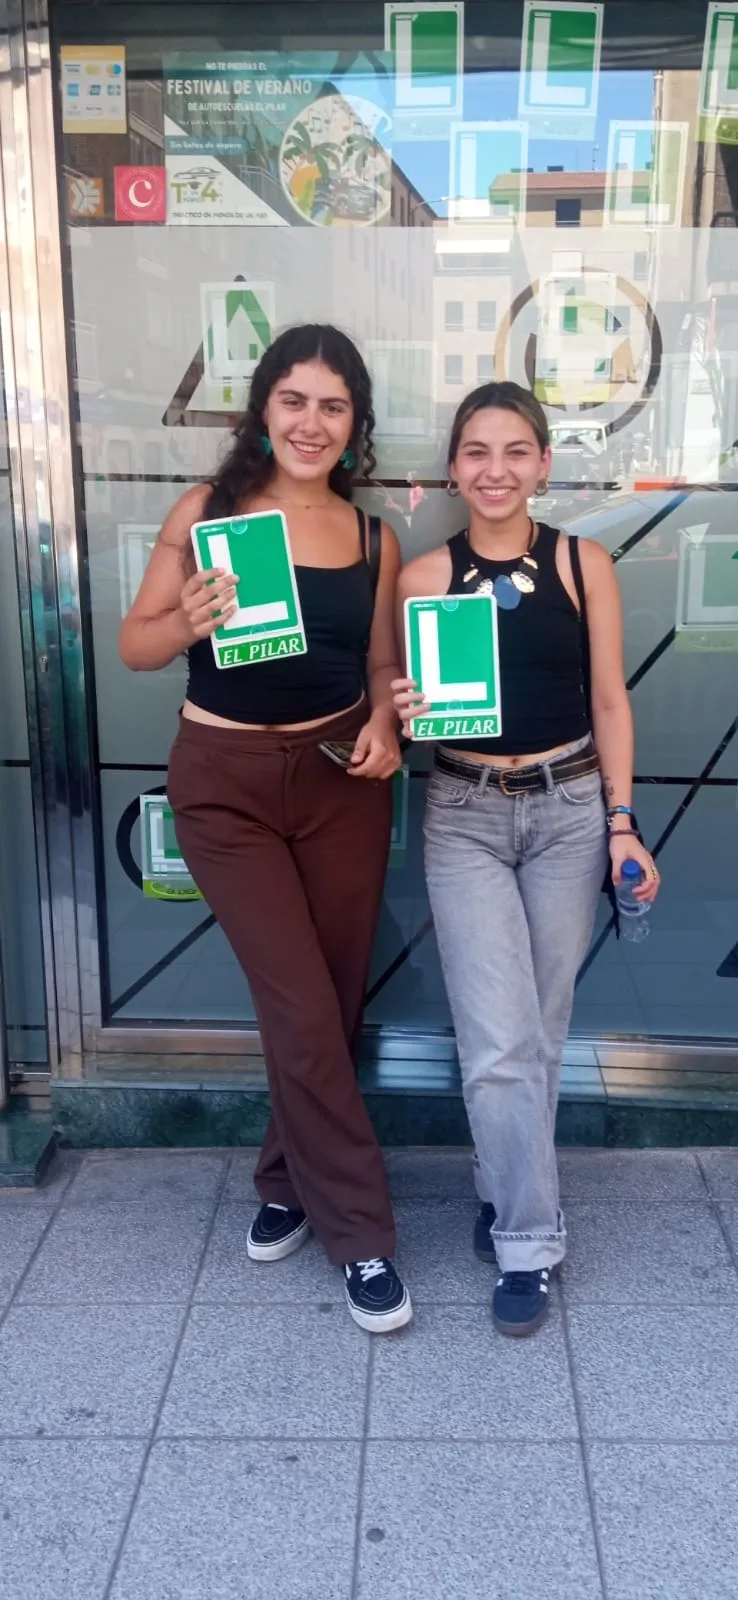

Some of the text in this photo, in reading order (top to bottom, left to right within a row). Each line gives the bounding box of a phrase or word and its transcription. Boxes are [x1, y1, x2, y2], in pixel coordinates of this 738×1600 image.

[166, 79, 312, 96] FESTIVAL DE VERANO
[395, 15, 451, 106] L
[529, 12, 586, 106] L
[614, 131, 671, 222] L
[207, 533, 289, 630] L
[223, 637, 301, 665] EL PILAR
[417, 610, 488, 703] L
[416, 719, 495, 736] EL PILAR
